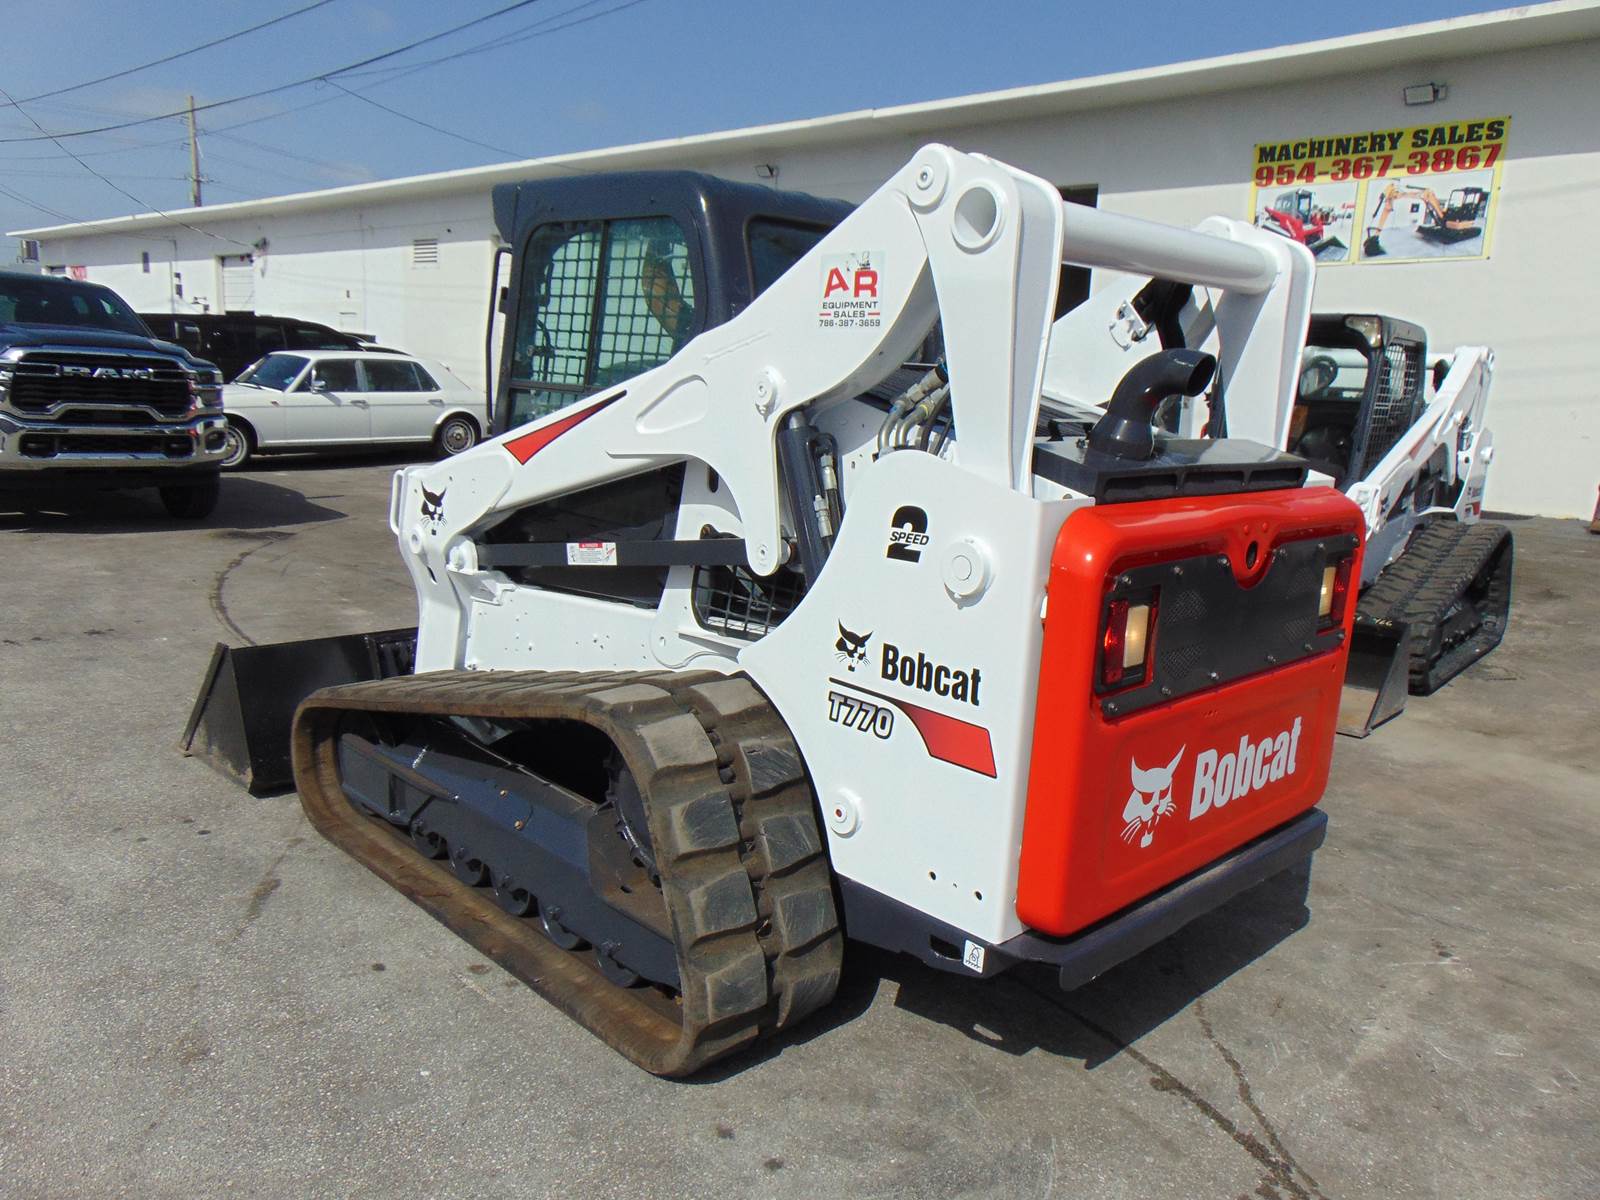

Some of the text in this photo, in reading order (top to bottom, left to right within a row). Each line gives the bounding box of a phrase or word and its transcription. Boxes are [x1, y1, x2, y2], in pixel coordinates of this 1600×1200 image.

[1258, 119, 1505, 164] MACHINERY SALES
[1254, 143, 1504, 188] 954-367-3867
[822, 301, 879, 310] EQUIPMENT
[833, 310, 866, 319] SALES
[62, 365, 153, 379] RAM
[886, 505, 930, 564] 2 SPEED
[881, 642, 982, 707] Bobcat
[828, 690, 895, 740] T770
[1189, 716, 1303, 821] Bobcat
